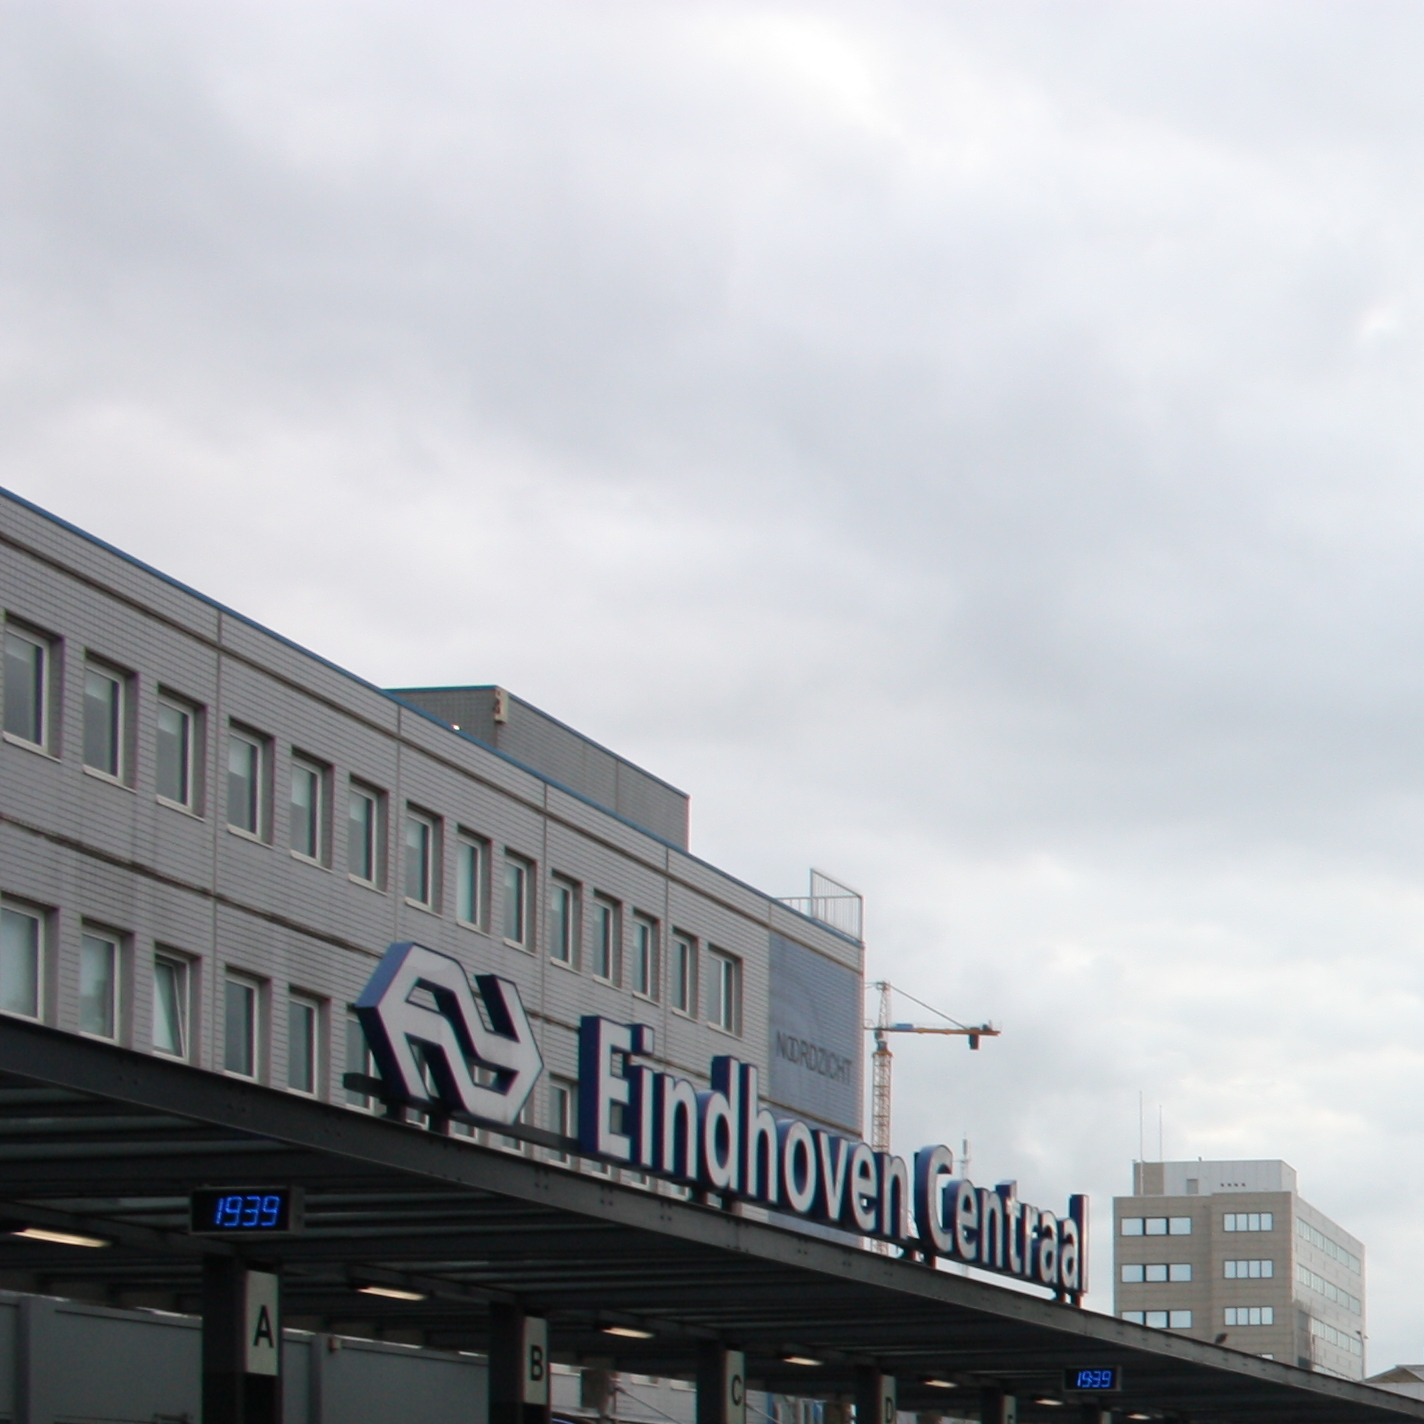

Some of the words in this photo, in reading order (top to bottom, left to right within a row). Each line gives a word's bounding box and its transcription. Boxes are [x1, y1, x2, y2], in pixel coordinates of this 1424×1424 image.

[582, 1015, 908, 1239] Eindhoven
[914, 1145, 1089, 1294] Centraal
[253, 1305, 274, 1348] A
[529, 1343, 544, 1382] B
[732, 1373, 743, 1406] C
[885, 1396, 893, 1424] D
